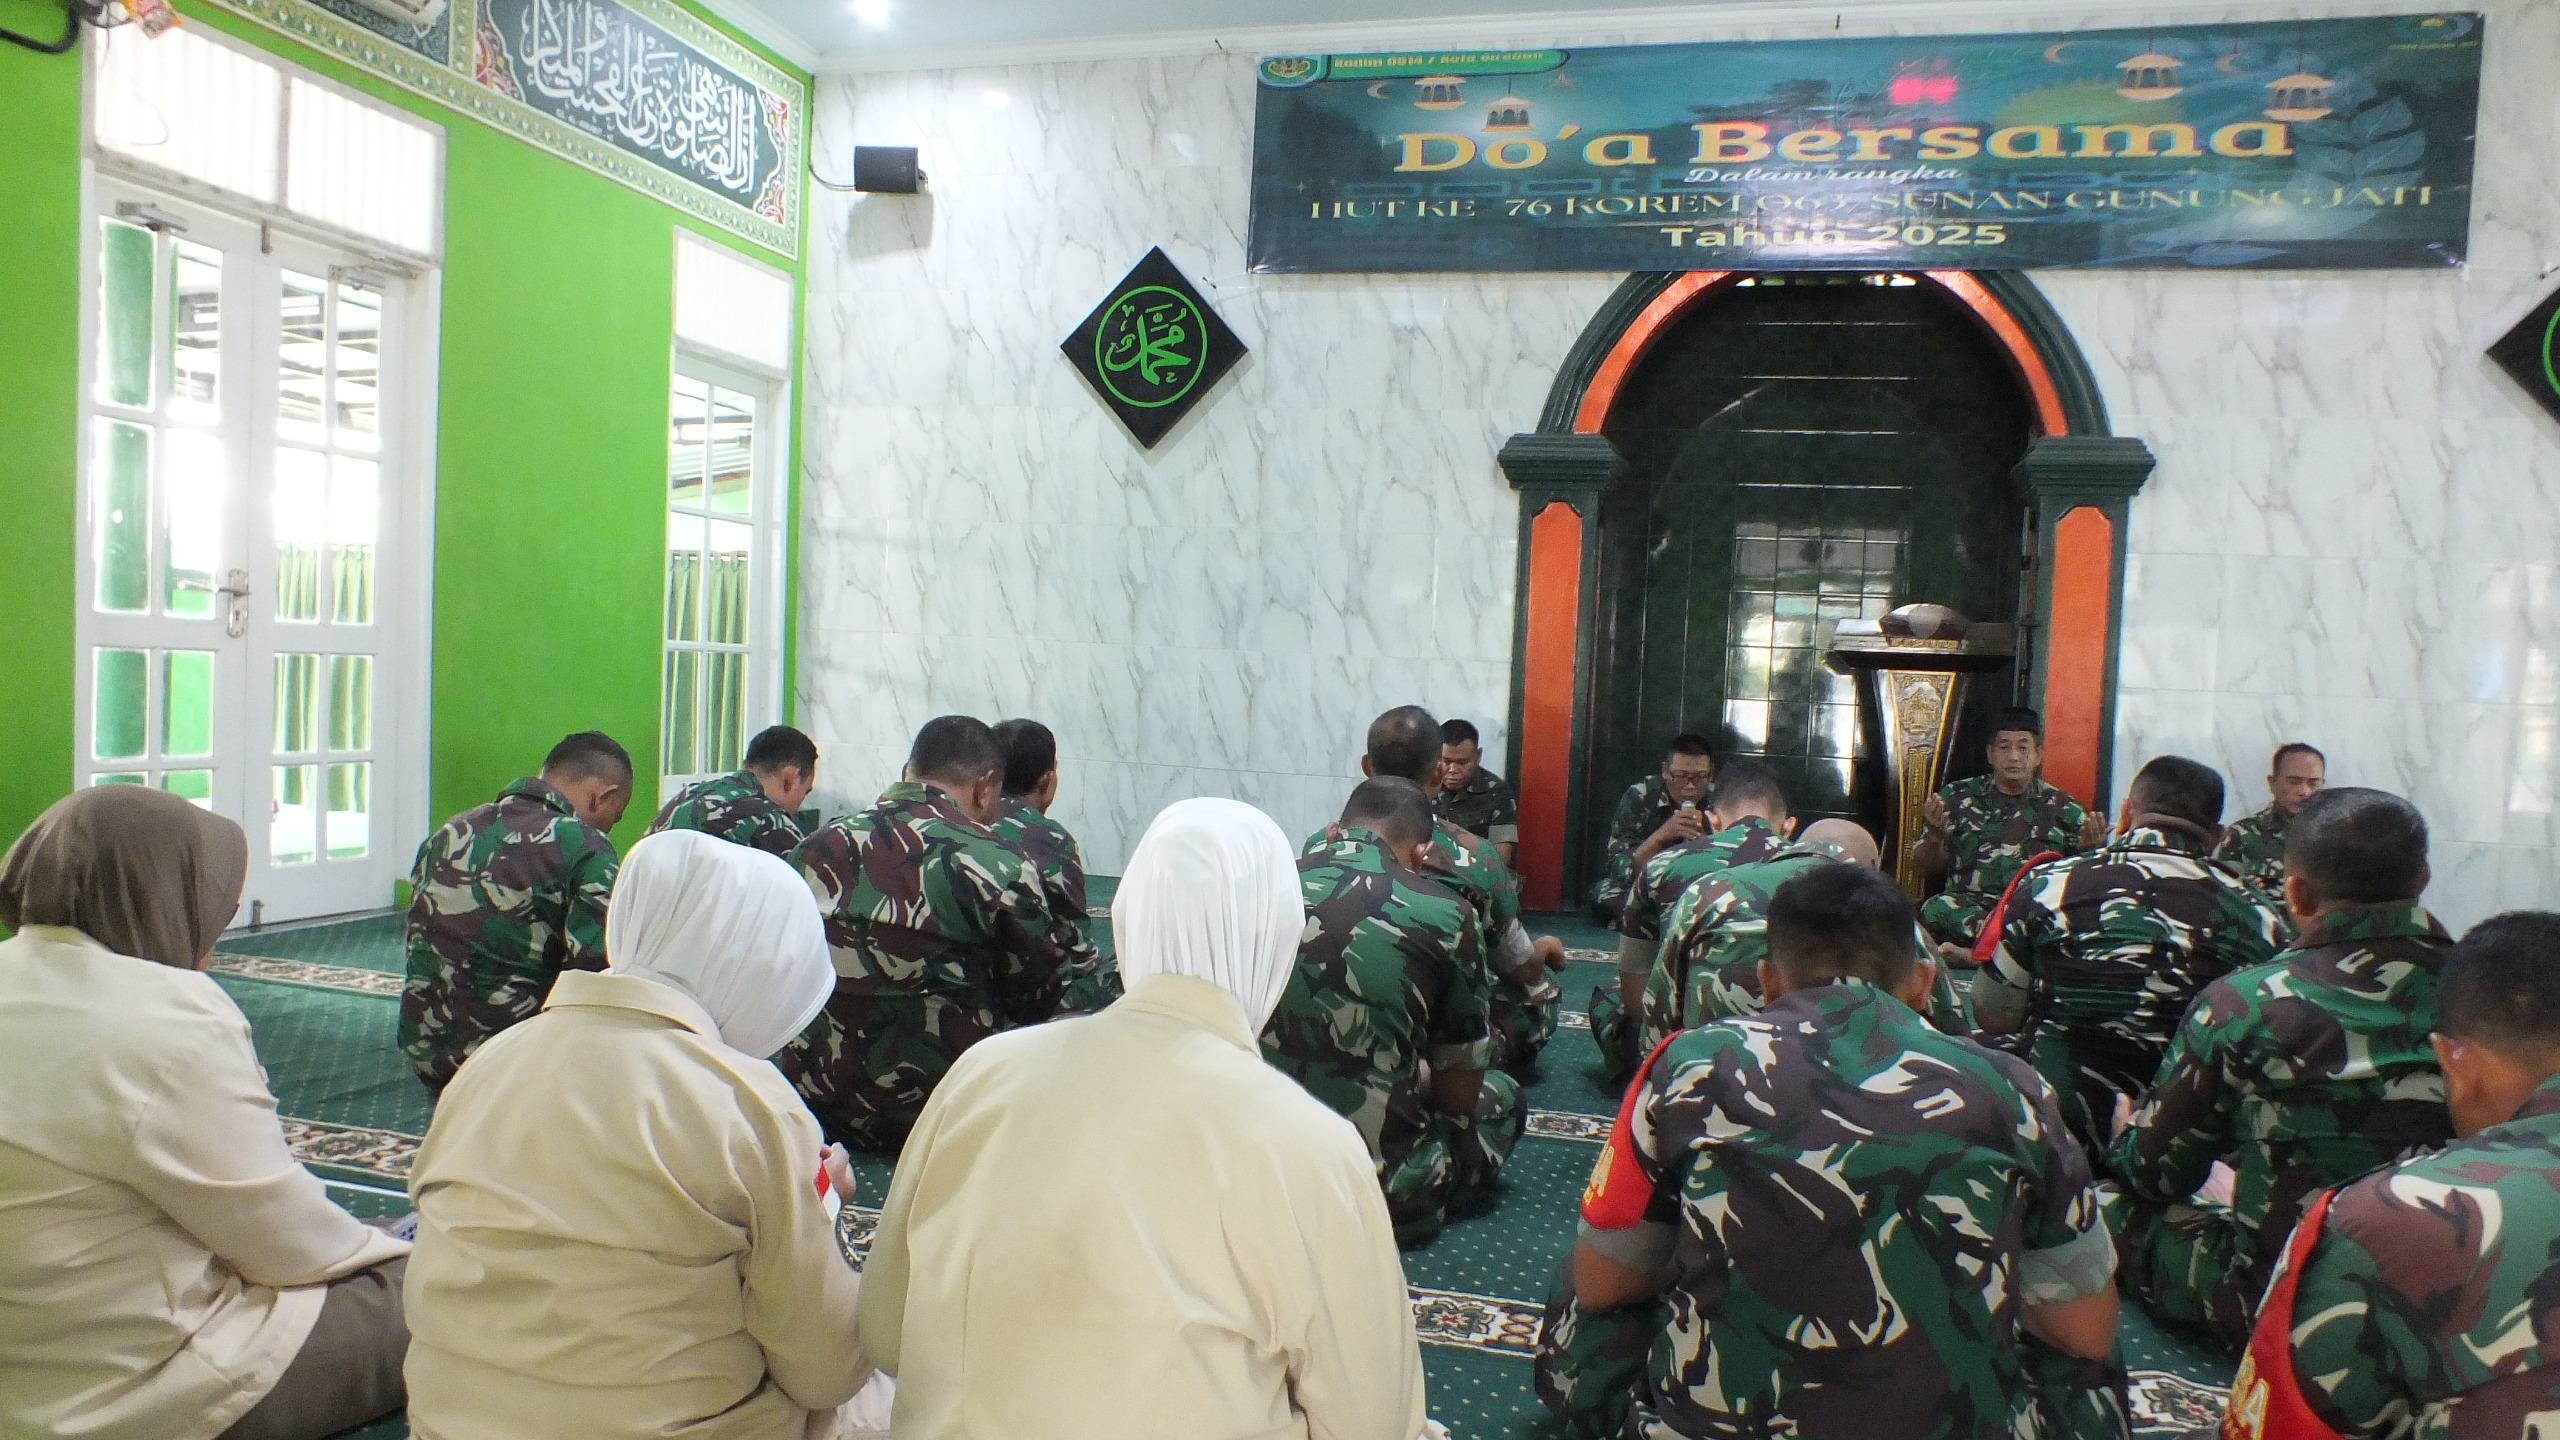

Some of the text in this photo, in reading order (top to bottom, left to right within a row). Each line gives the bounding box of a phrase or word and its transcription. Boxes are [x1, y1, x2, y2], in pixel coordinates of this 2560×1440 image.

[1688, 120, 2295, 164] Bersama
[1683, 164, 1963, 185] Dalam rangka
[1311, 200, 1405, 218] HUT
[1418, 199, 1475, 217] KE
[1505, 198, 1552, 217] 76
[1566, 192, 1741, 216] KOREM
[2064, 186, 2311, 209] GUNUNG
[2320, 185, 2432, 208] JATI
[1660, 224, 2007, 247] Tahun 2025
